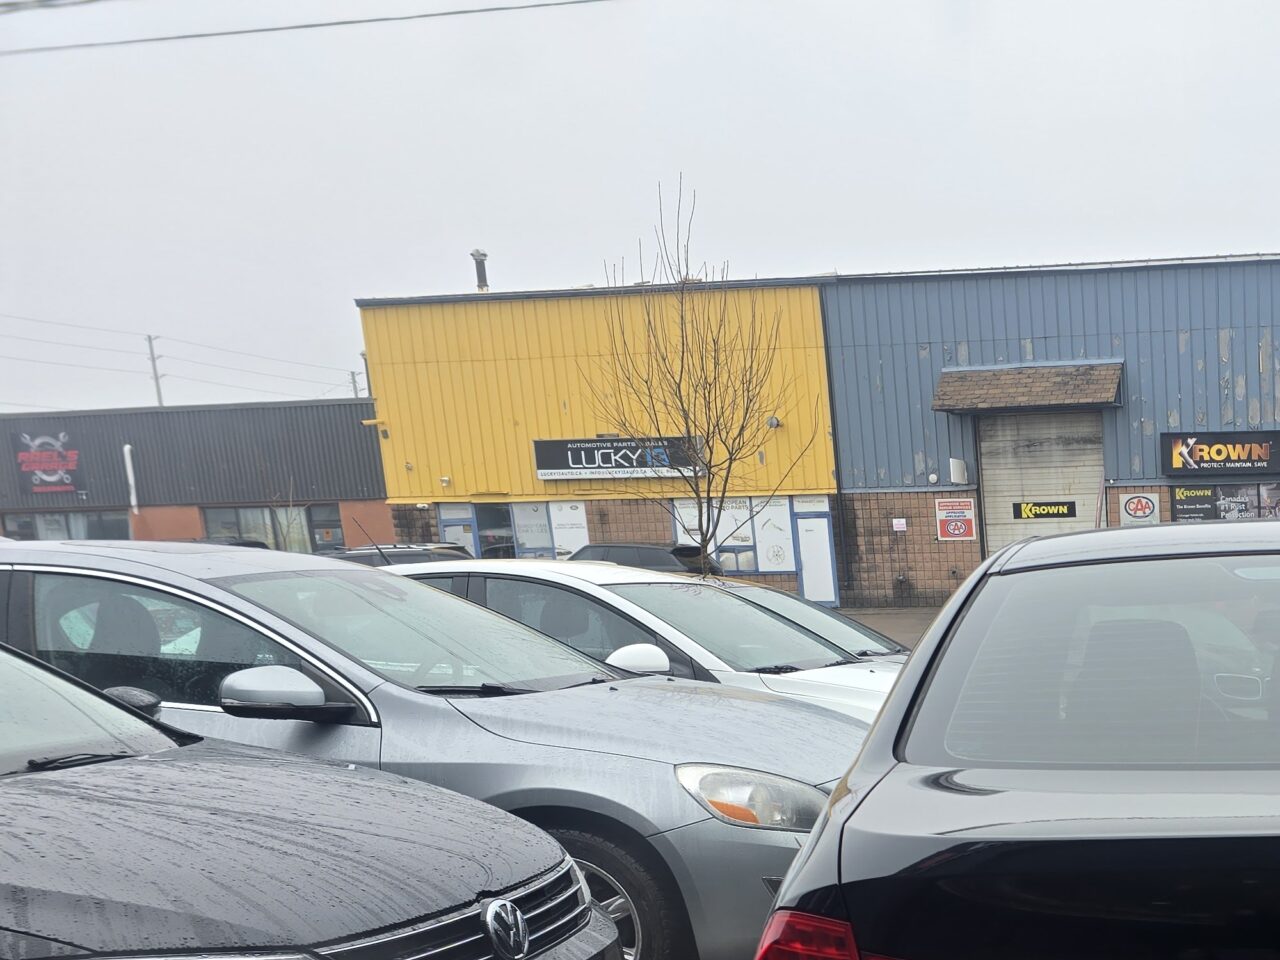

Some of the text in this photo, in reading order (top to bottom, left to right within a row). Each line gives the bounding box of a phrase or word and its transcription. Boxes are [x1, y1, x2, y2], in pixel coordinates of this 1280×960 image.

[567, 449, 642, 468] LUCKY
[1172, 438, 1269, 469] KROWN
[1175, 488, 1211, 499] KROWN
[1021, 503, 1068, 518] KROWN
[1127, 499, 1151, 515] CAA
[949, 523, 964, 533] CAA
